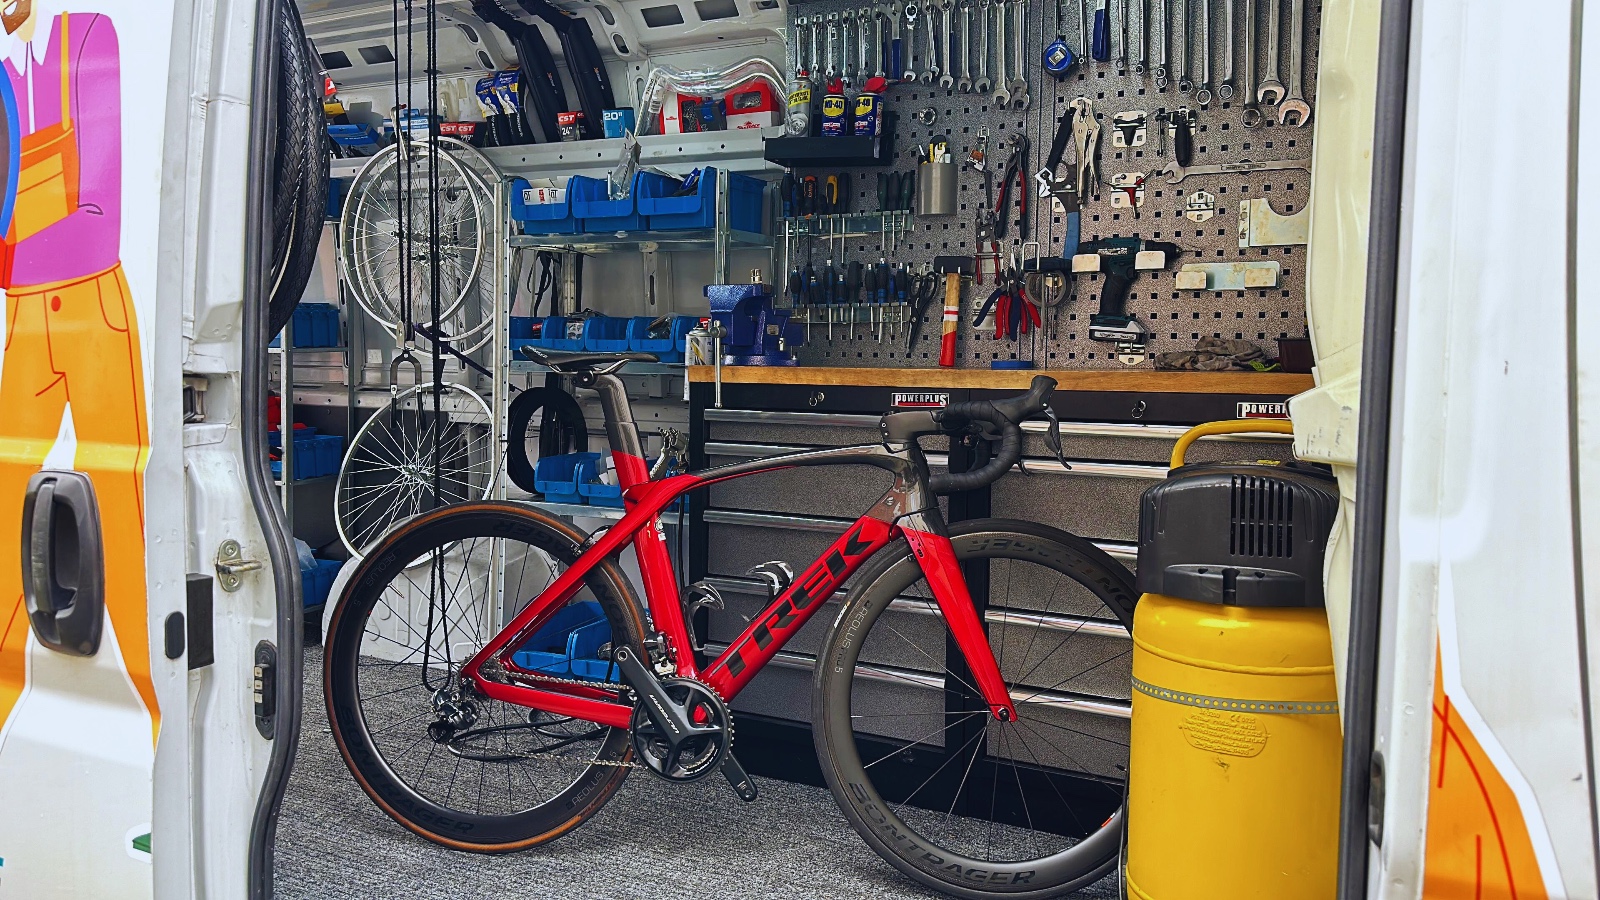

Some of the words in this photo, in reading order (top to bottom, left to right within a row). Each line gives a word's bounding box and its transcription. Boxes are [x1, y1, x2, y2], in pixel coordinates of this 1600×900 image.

[604, 112, 623, 120] 20"
[825, 101, 843, 109] WD-40
[895, 394, 947, 406] POWERPLUS
[365, 552, 397, 587] AEOLUS
[725, 523, 875, 679] TREK
[842, 606, 868, 649] AEOLUS
[340, 705, 475, 834] BONTRAGER
[571, 770, 604, 806] AEOLUS
[848, 782, 1037, 885] BONTRAGER
